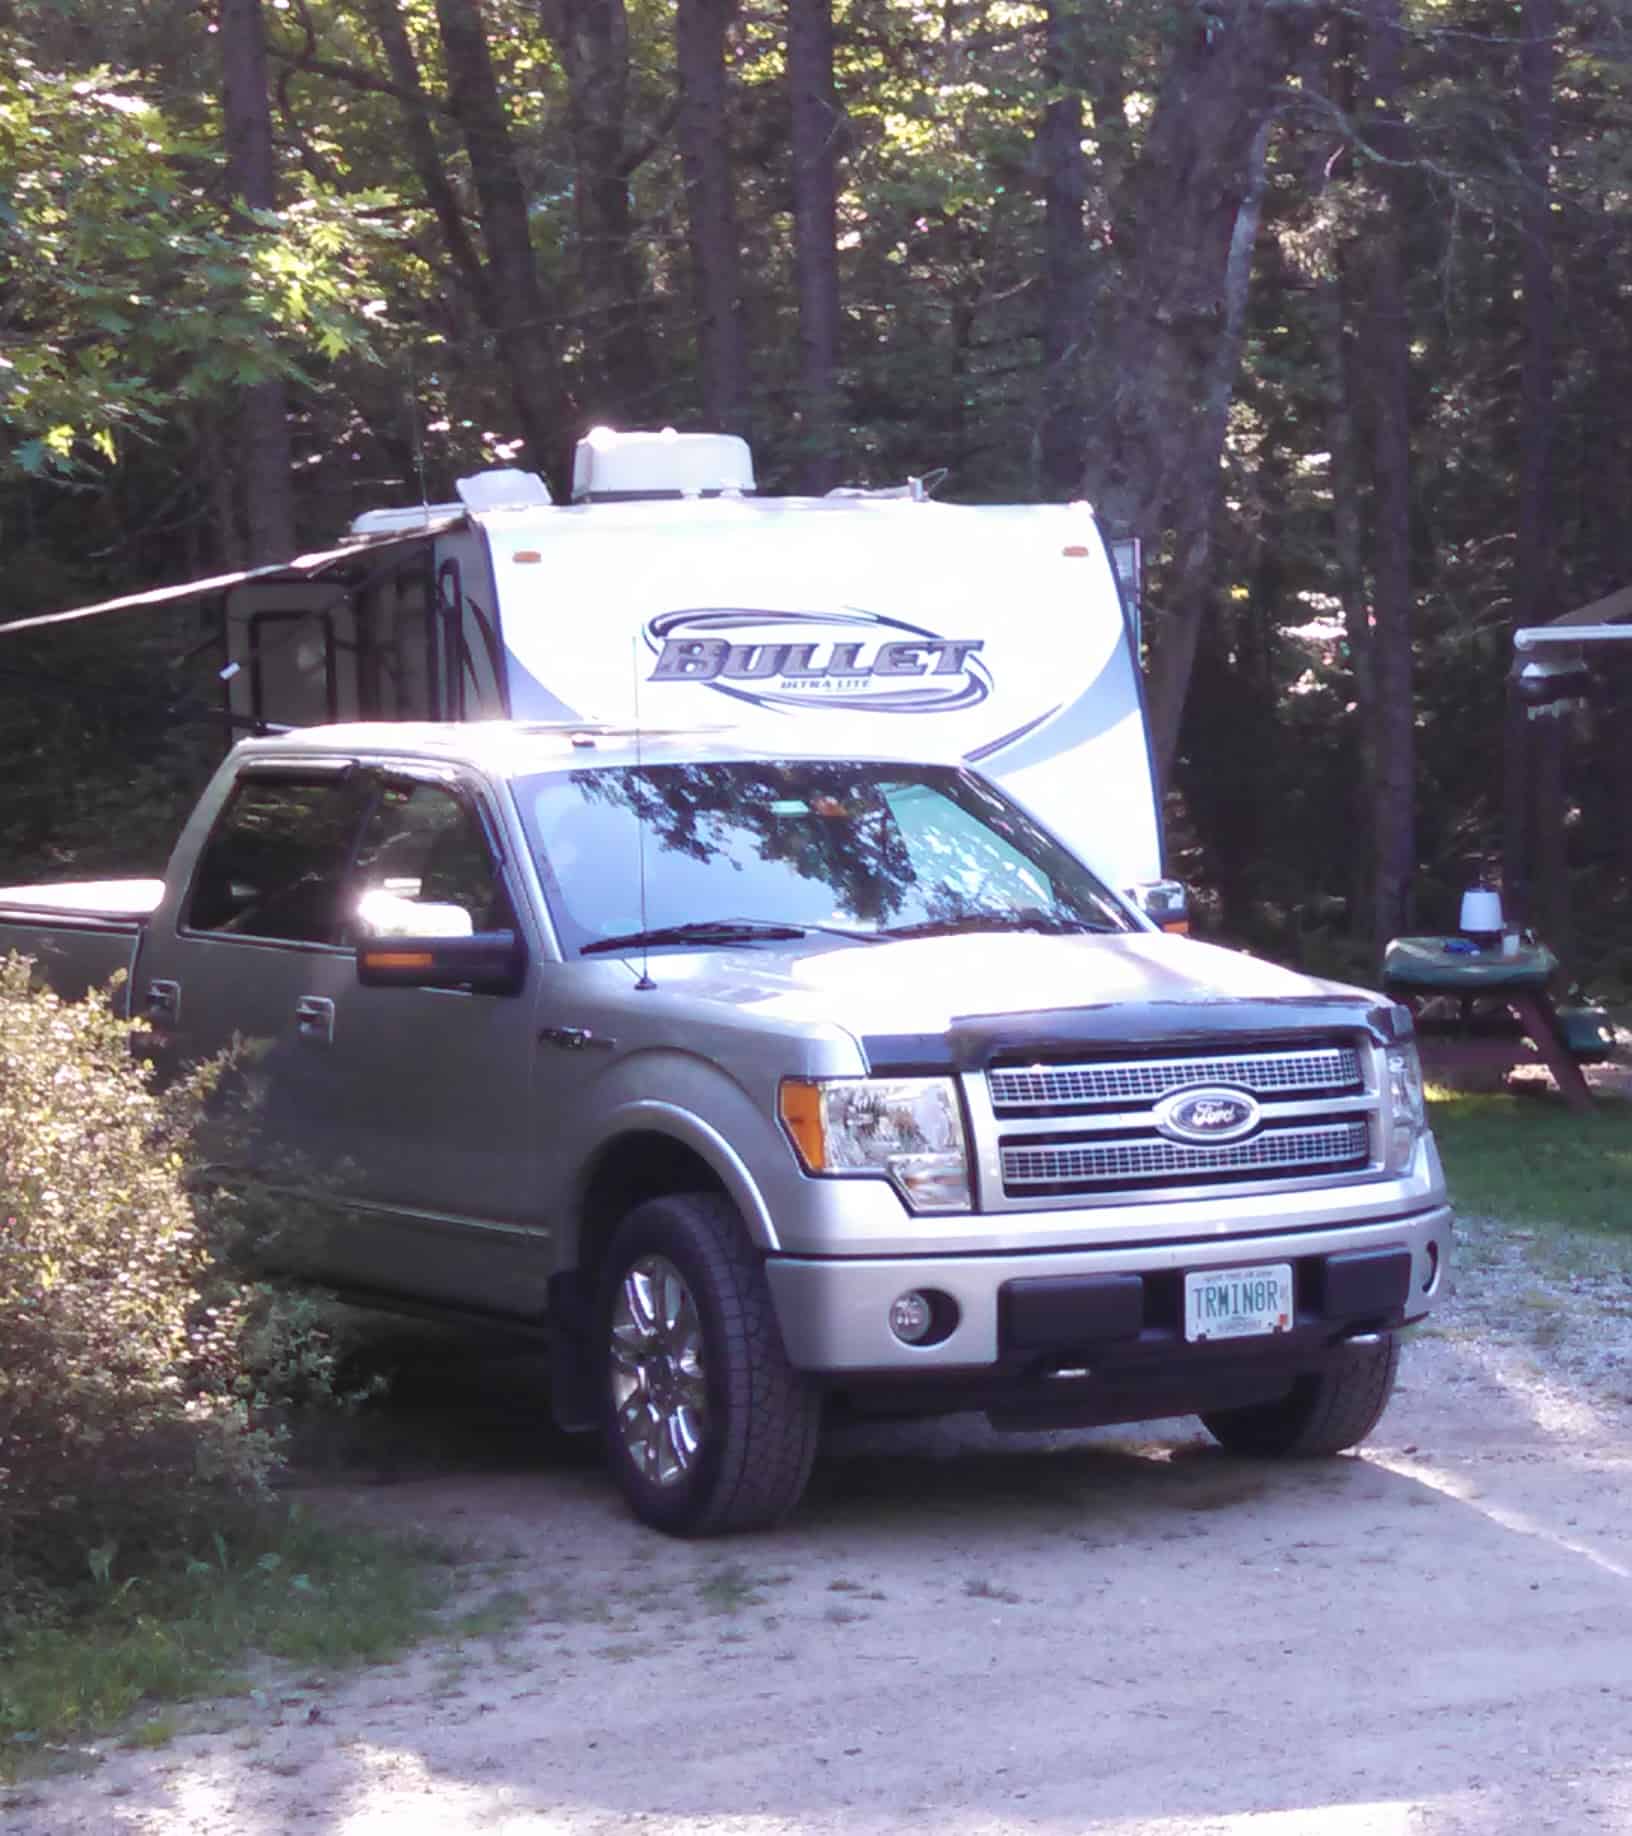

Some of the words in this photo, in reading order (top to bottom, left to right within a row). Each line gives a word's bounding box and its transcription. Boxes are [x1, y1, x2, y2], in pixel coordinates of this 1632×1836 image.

[646, 637, 985, 682] BULLET
[1191, 1101, 1235, 1126] Ford
[1192, 1279, 1278, 1319] TRMIN8R
